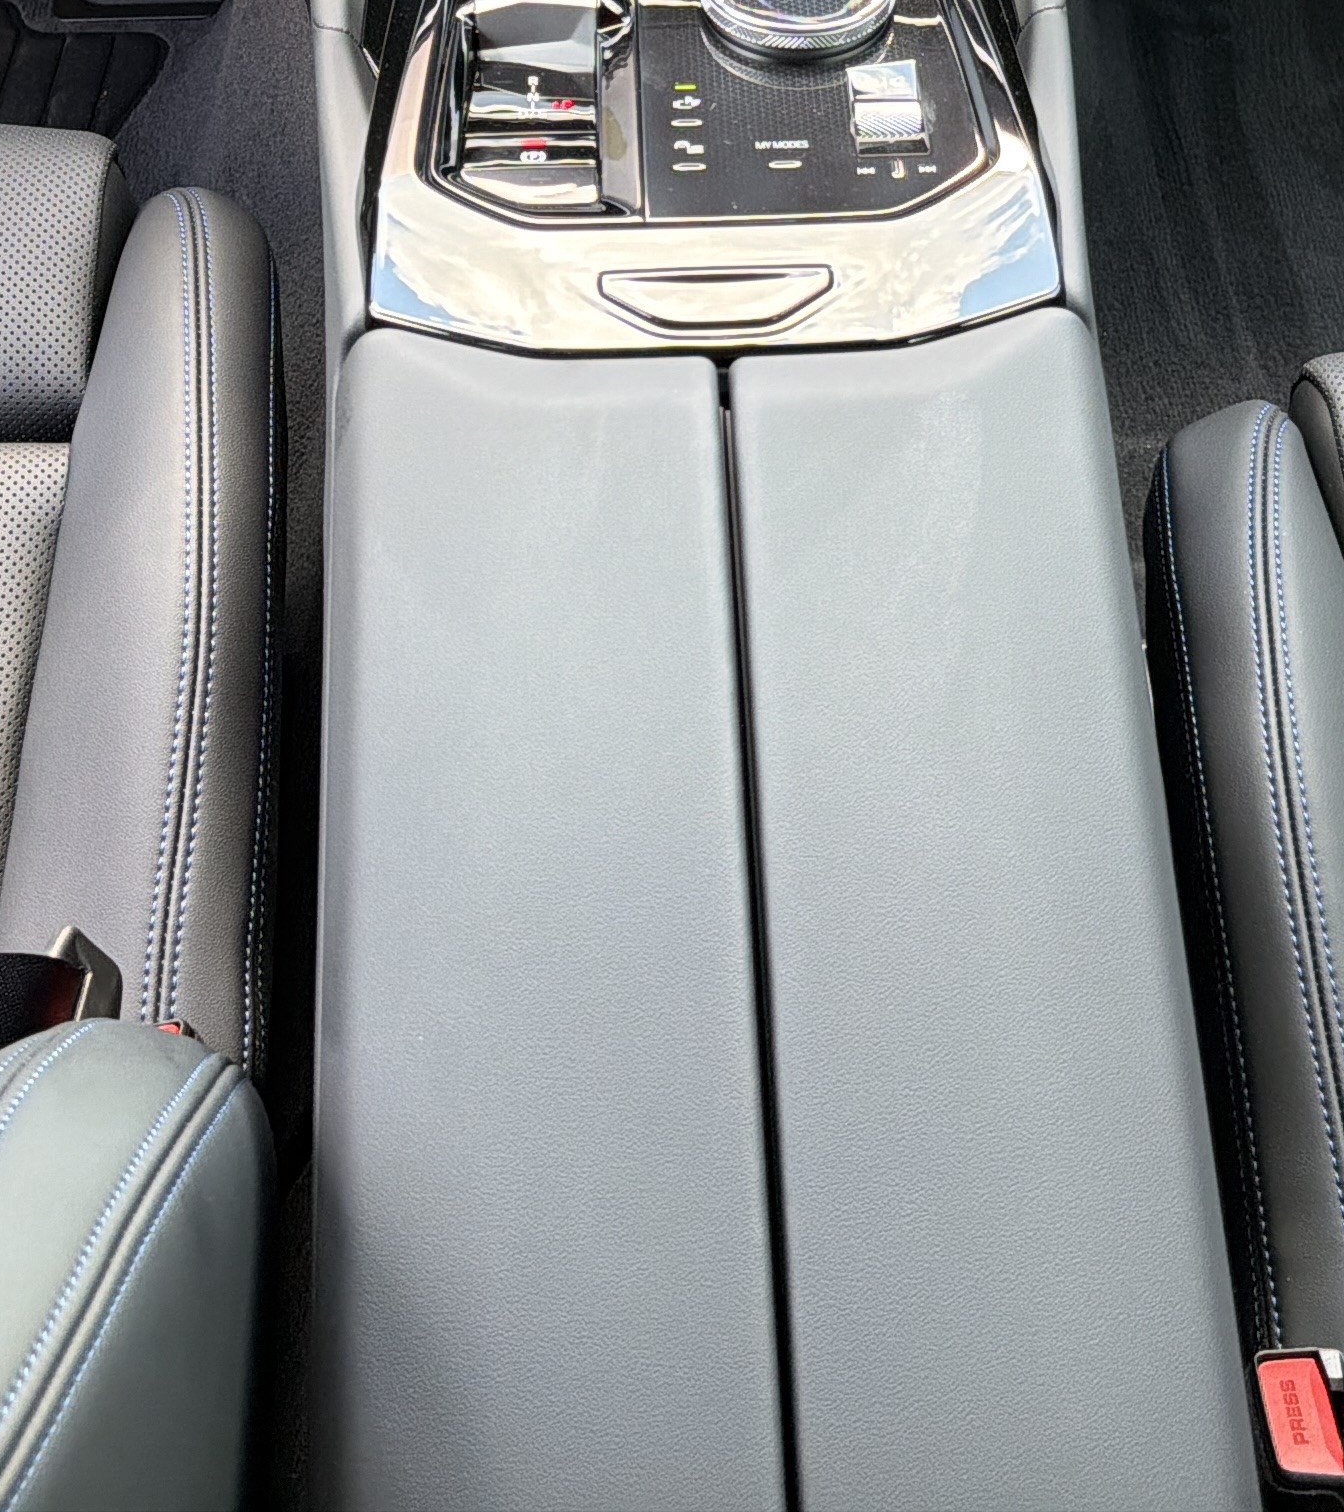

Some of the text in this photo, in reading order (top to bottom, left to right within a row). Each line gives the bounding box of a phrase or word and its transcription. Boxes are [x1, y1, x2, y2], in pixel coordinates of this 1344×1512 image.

[755, 139, 810, 150] MY MODES
[1279, 1379, 1309, 1446] PRESS
